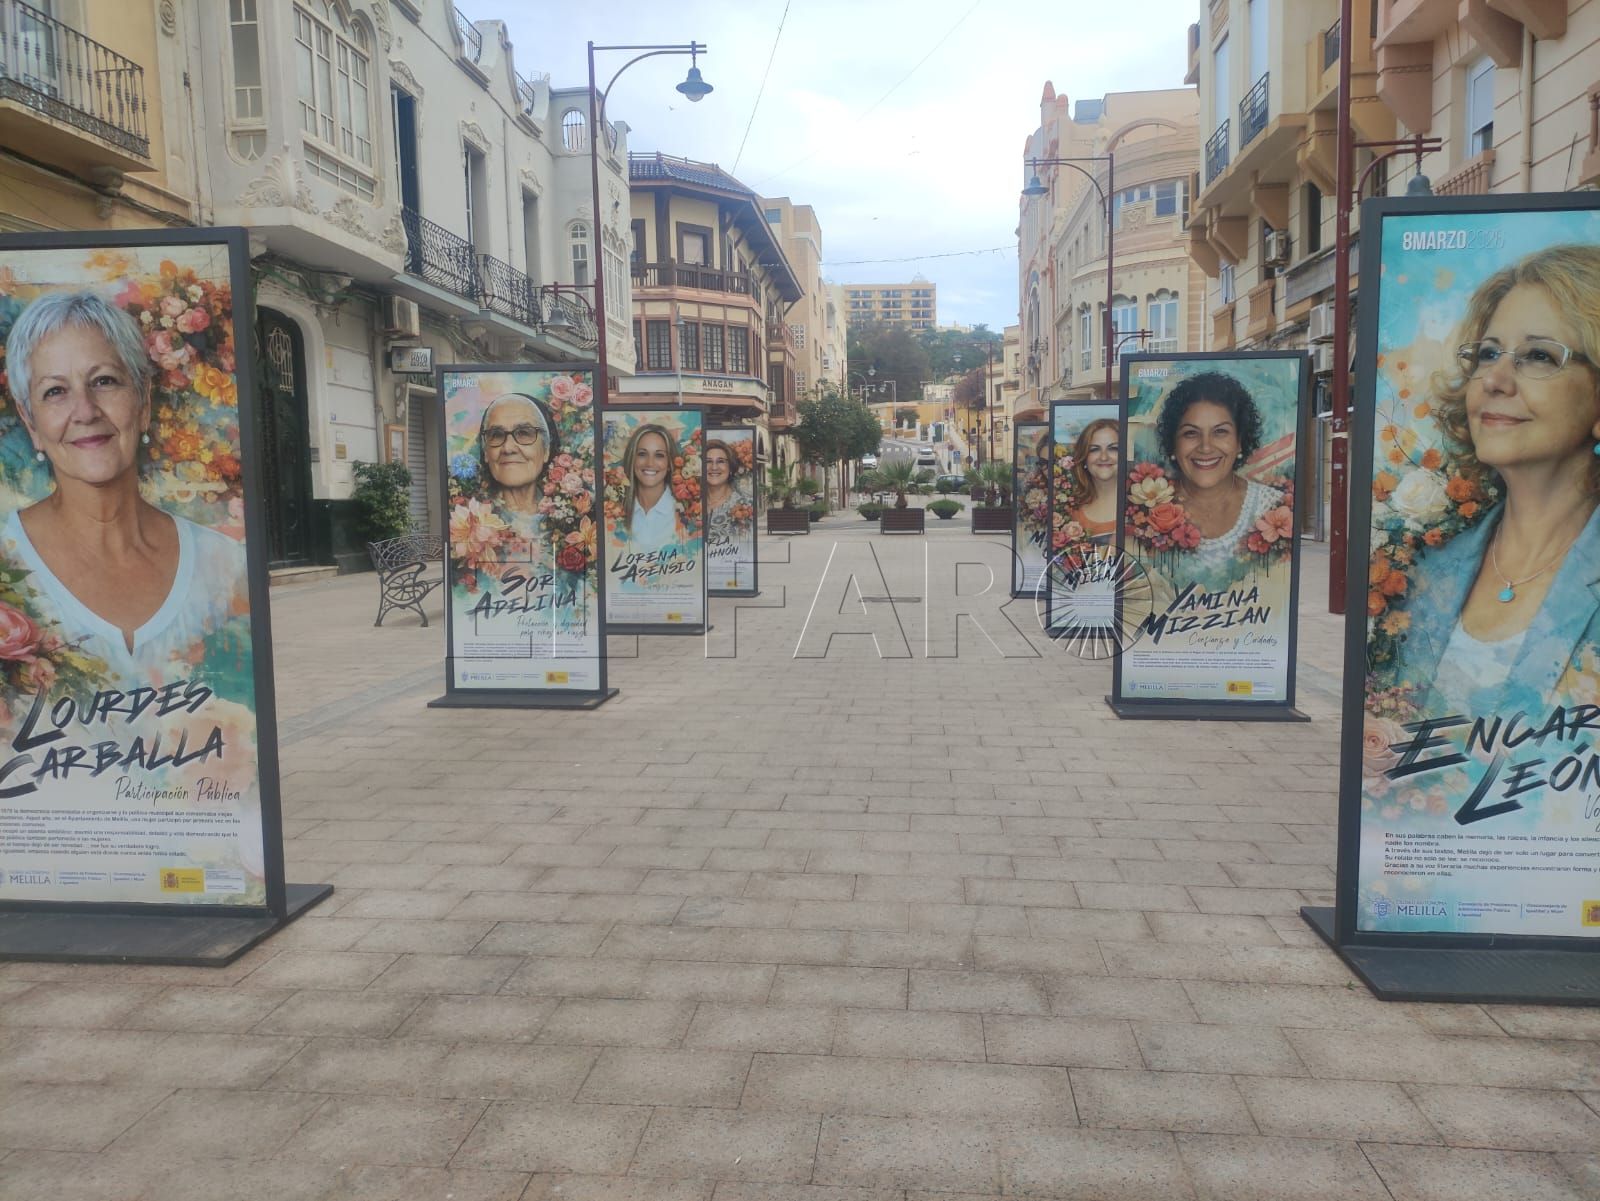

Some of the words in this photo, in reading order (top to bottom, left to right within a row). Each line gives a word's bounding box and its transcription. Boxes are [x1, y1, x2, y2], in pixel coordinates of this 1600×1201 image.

[611, 548, 677, 572] LORENA
[619, 560, 696, 584] ASENSIO
[501, 566, 555, 596] SOR
[464, 590, 576, 621] ADELINA
[1166, 581, 1258, 614] YAMINA
[1132, 606, 1271, 645] MIZZIAN
[12, 680, 213, 752] LOURDES
[0, 726, 225, 798] CARBALLA
[115, 776, 189, 806] Participación
[196, 776, 240, 802] Pública
[9, 874, 51, 884] MELILLA
[1398, 905, 1447, 916] MELILLA
